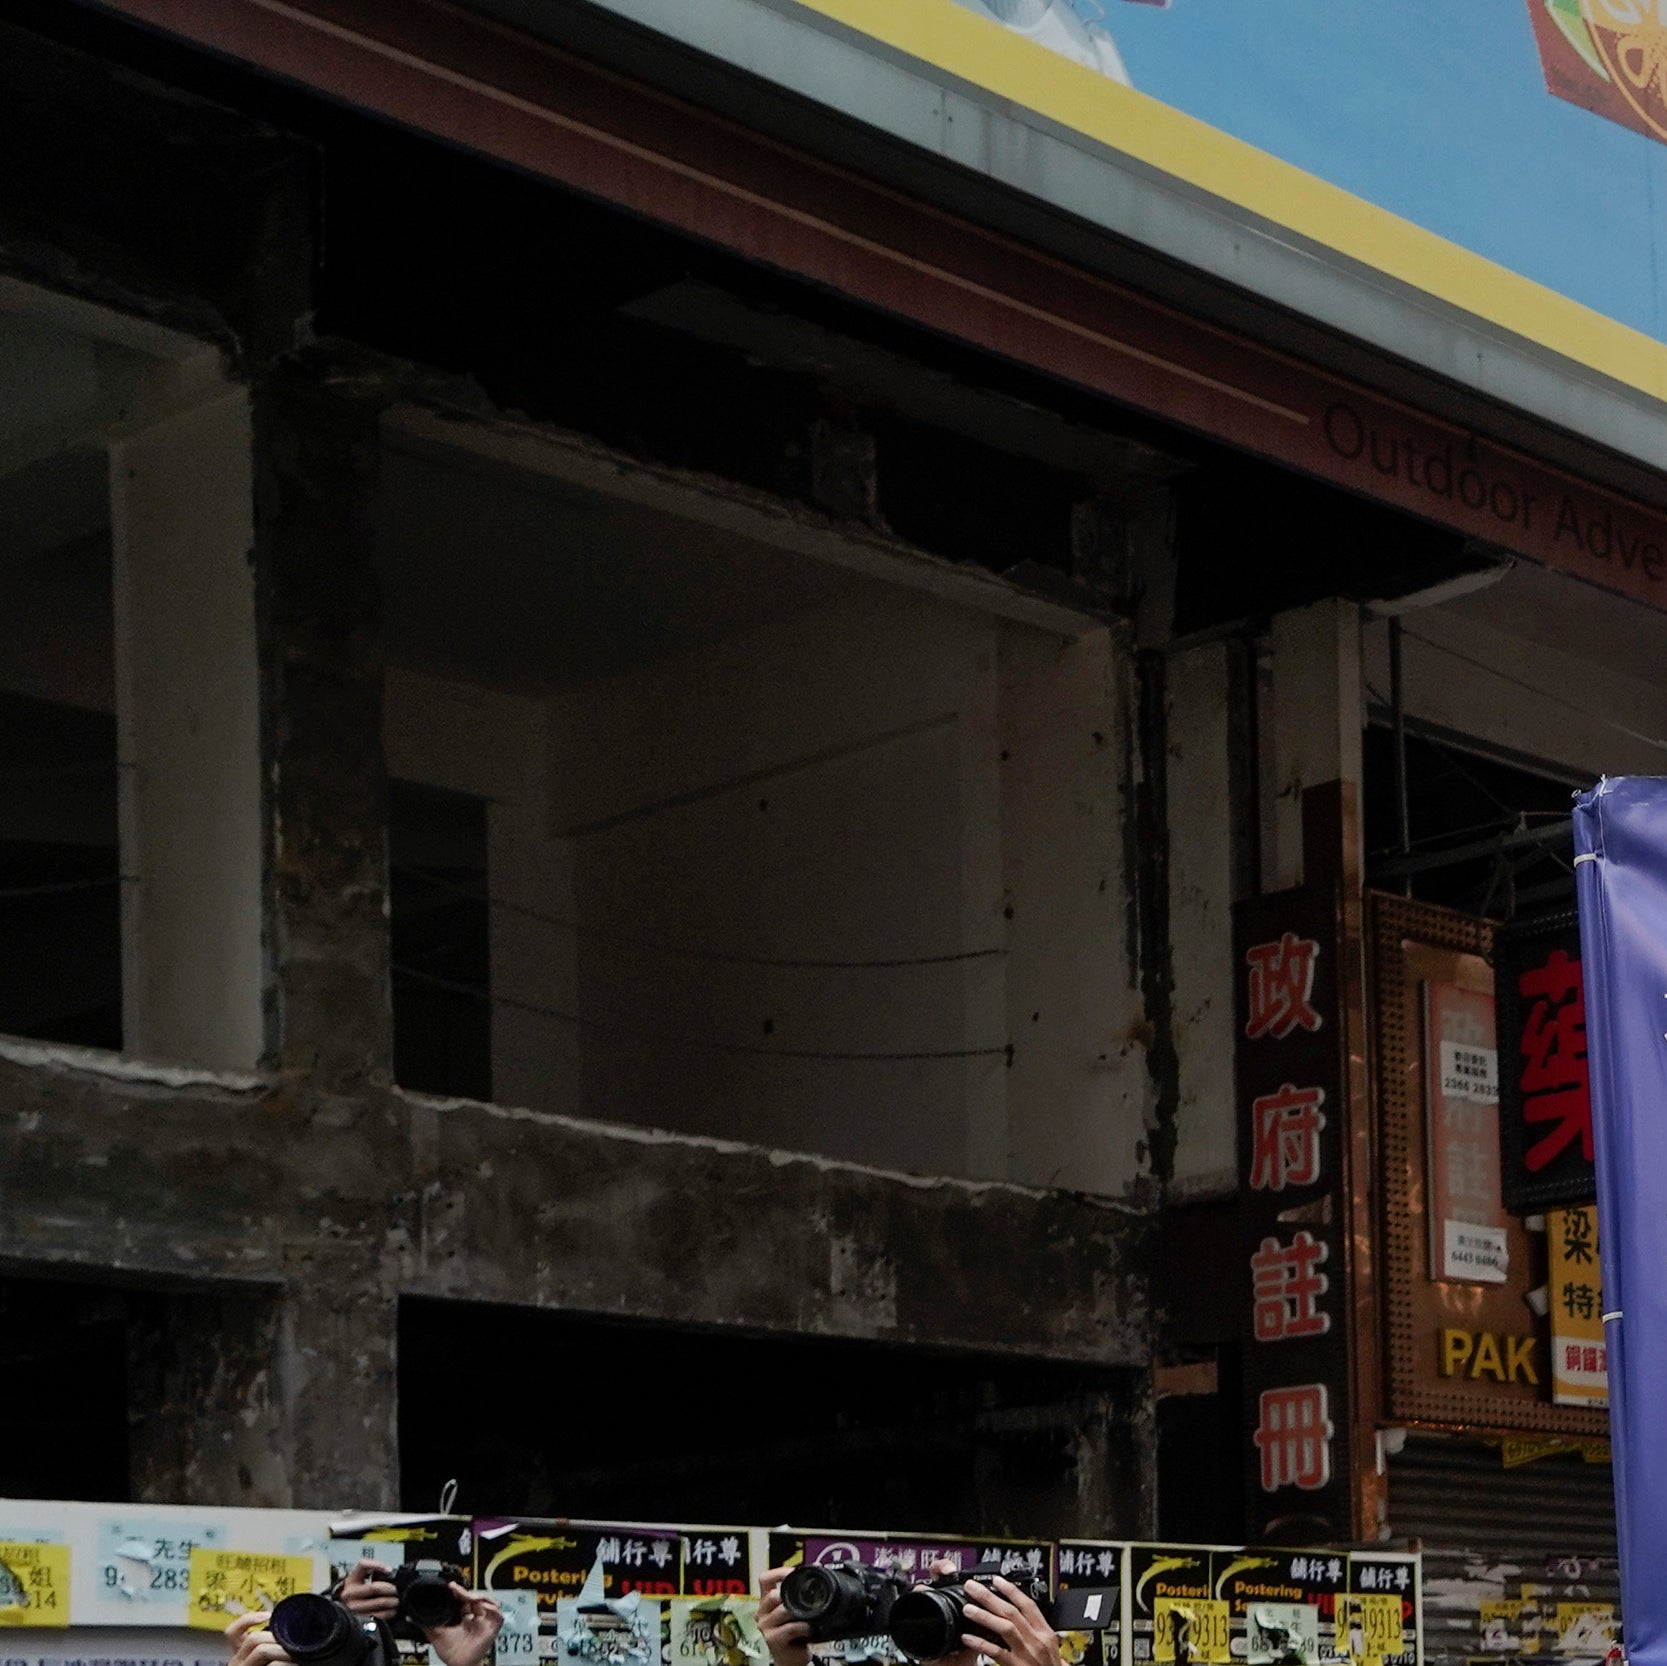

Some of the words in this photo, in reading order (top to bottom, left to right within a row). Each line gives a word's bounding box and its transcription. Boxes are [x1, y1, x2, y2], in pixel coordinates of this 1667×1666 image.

[1323, 402, 1535, 531] Outdoor
[1245, 931, 1334, 1493] 政府註冊
[1443, 1328, 1539, 1385] PAK
[1234, 1581, 1303, 1600] Postering
